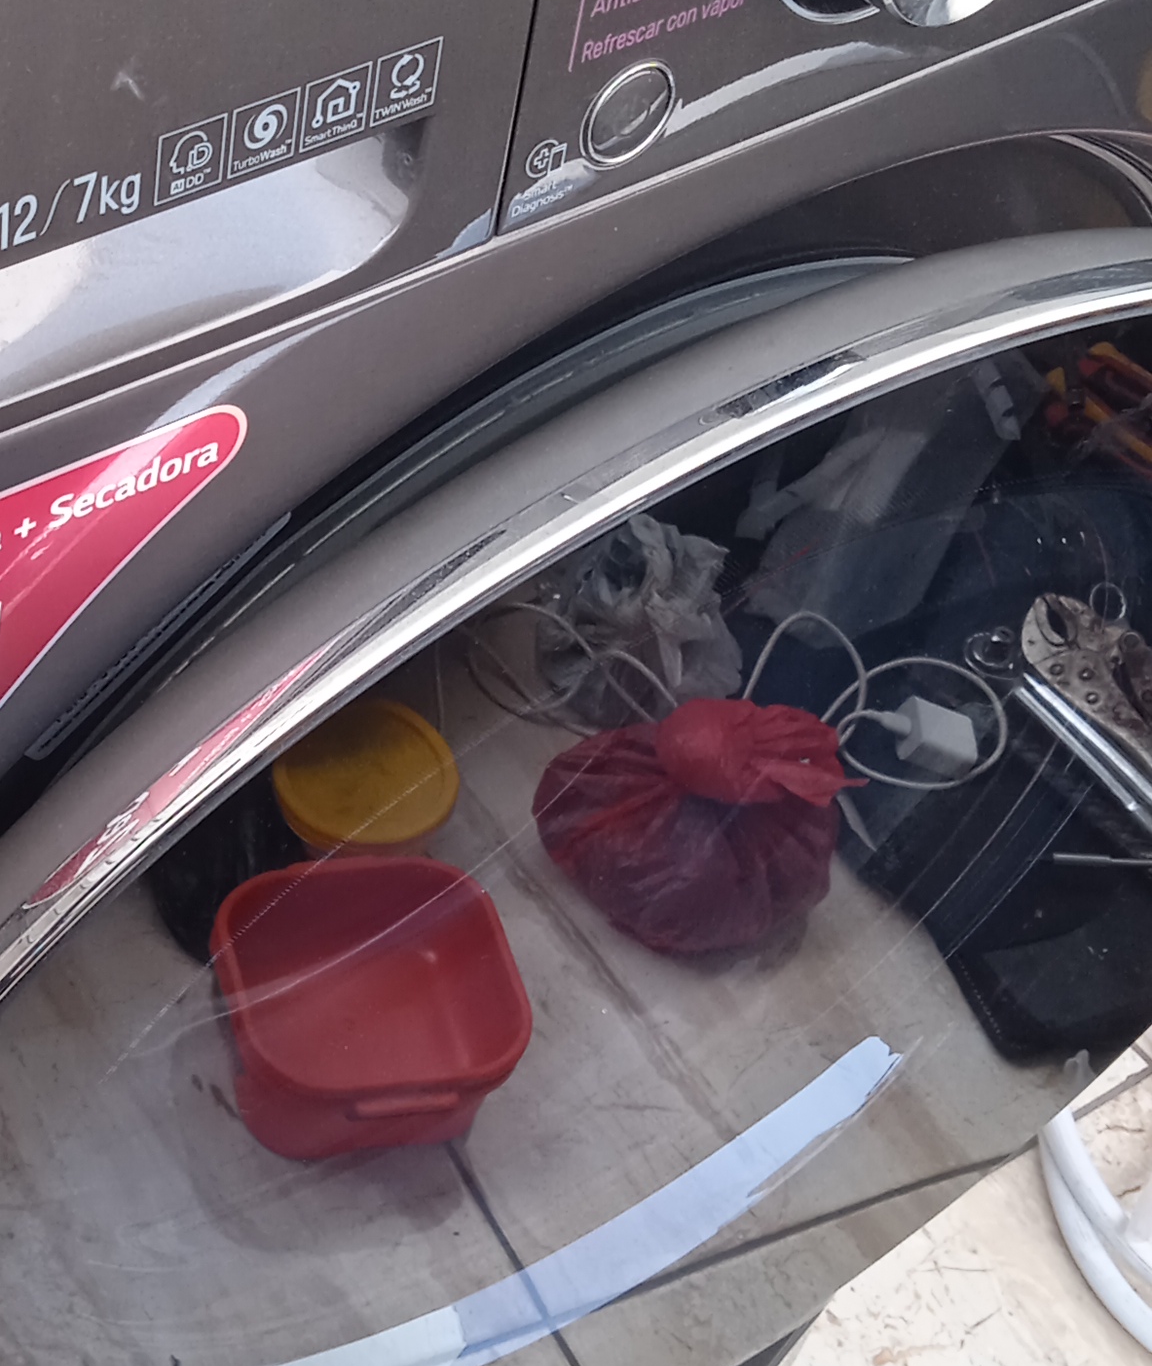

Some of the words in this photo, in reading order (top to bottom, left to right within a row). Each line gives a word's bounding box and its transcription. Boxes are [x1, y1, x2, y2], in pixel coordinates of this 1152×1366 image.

[581, 18, 665, 63] Refrescar
[666, 5, 698, 32] con
[13, 515, 38, 539] +
[49, 440, 220, 530] Secadora
